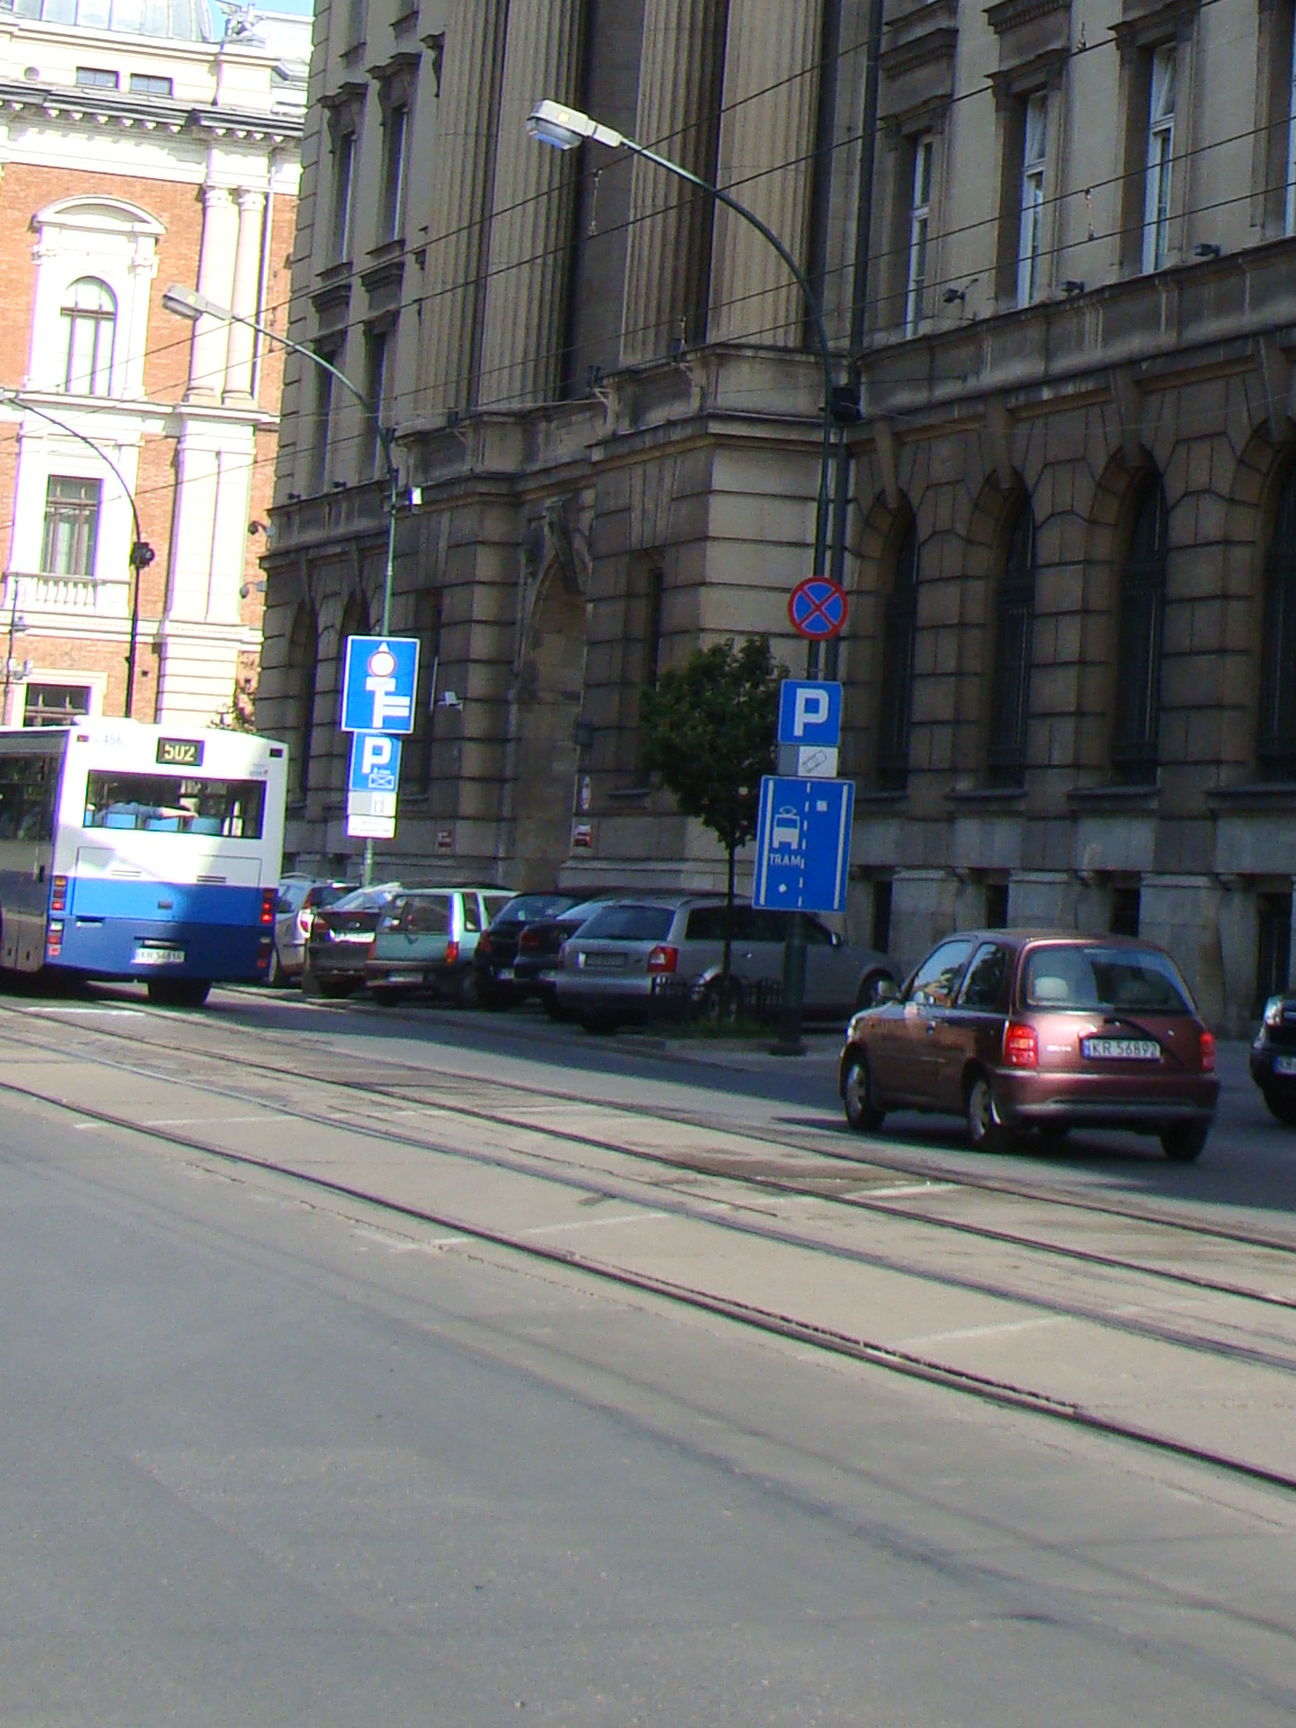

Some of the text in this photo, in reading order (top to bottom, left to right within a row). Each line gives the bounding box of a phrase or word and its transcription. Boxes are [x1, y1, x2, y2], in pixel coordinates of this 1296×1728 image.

[793, 688, 829, 736] P
[163, 743, 196, 762] 502
[361, 736, 391, 774] P
[769, 853, 801, 867] TRAM
[1092, 1040, 1112, 1057] KR
